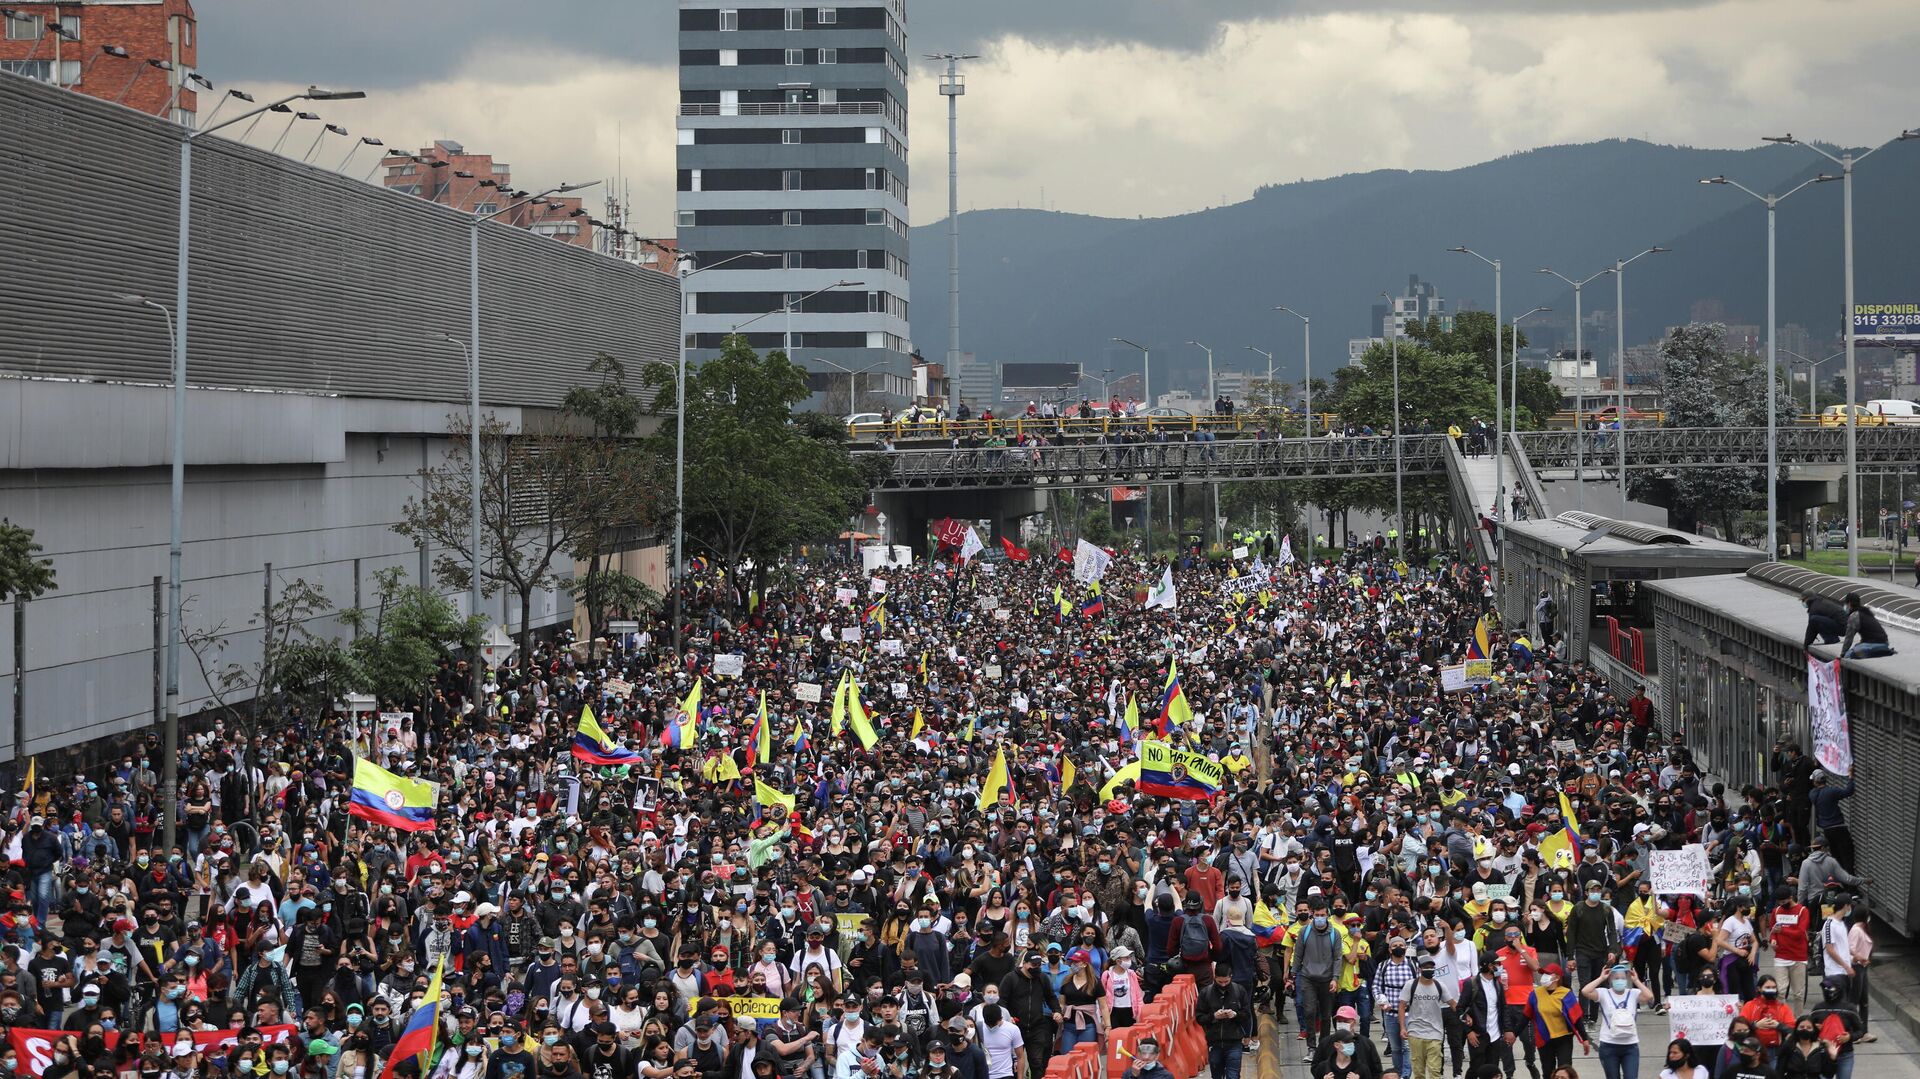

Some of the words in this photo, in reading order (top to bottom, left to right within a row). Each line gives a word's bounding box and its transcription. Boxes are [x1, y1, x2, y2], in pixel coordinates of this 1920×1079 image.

[1854, 315, 1878, 326] 315
[1148, 748, 1163, 761] NO
[1169, 749, 1190, 763] HAY
[842, 920, 853, 929] LA
